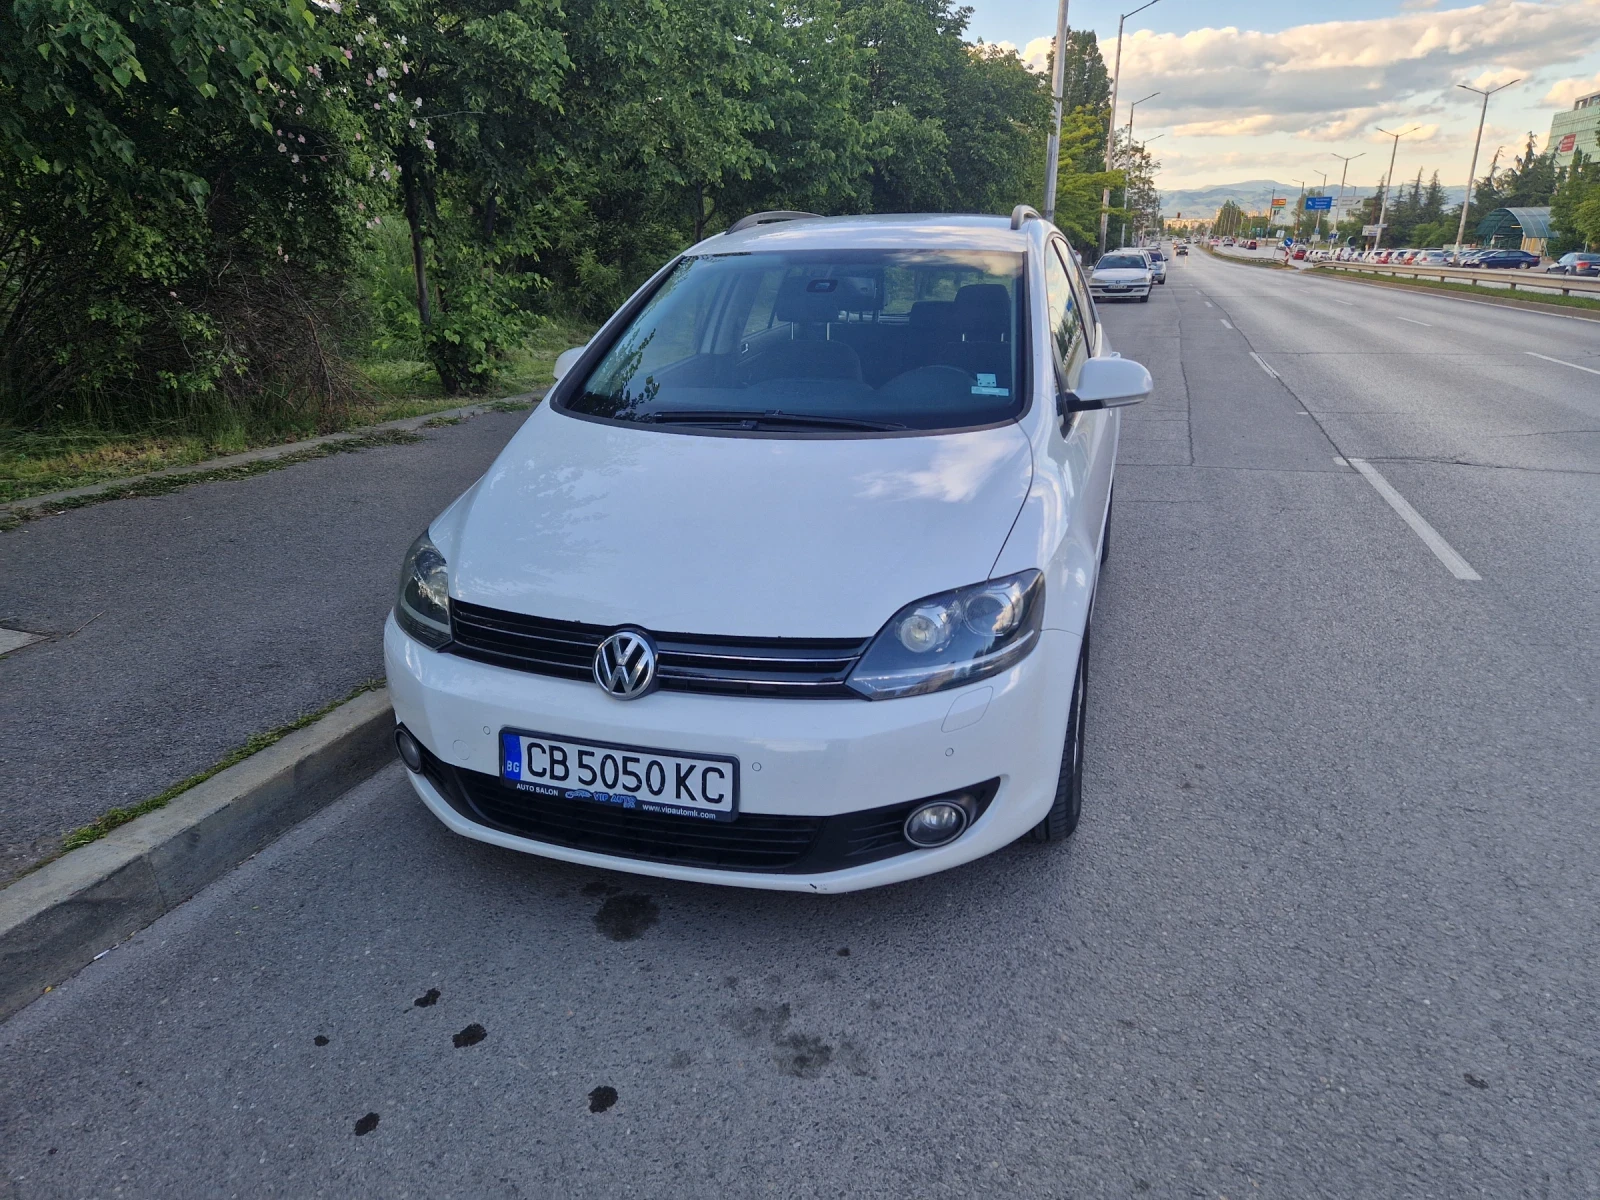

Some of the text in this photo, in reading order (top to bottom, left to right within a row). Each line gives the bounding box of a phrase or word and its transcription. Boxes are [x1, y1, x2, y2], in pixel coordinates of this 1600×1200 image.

[506, 760, 520, 773] BG
[526, 742, 726, 804] CB 5050 KC
[516, 782, 559, 797] AUTO SALON
